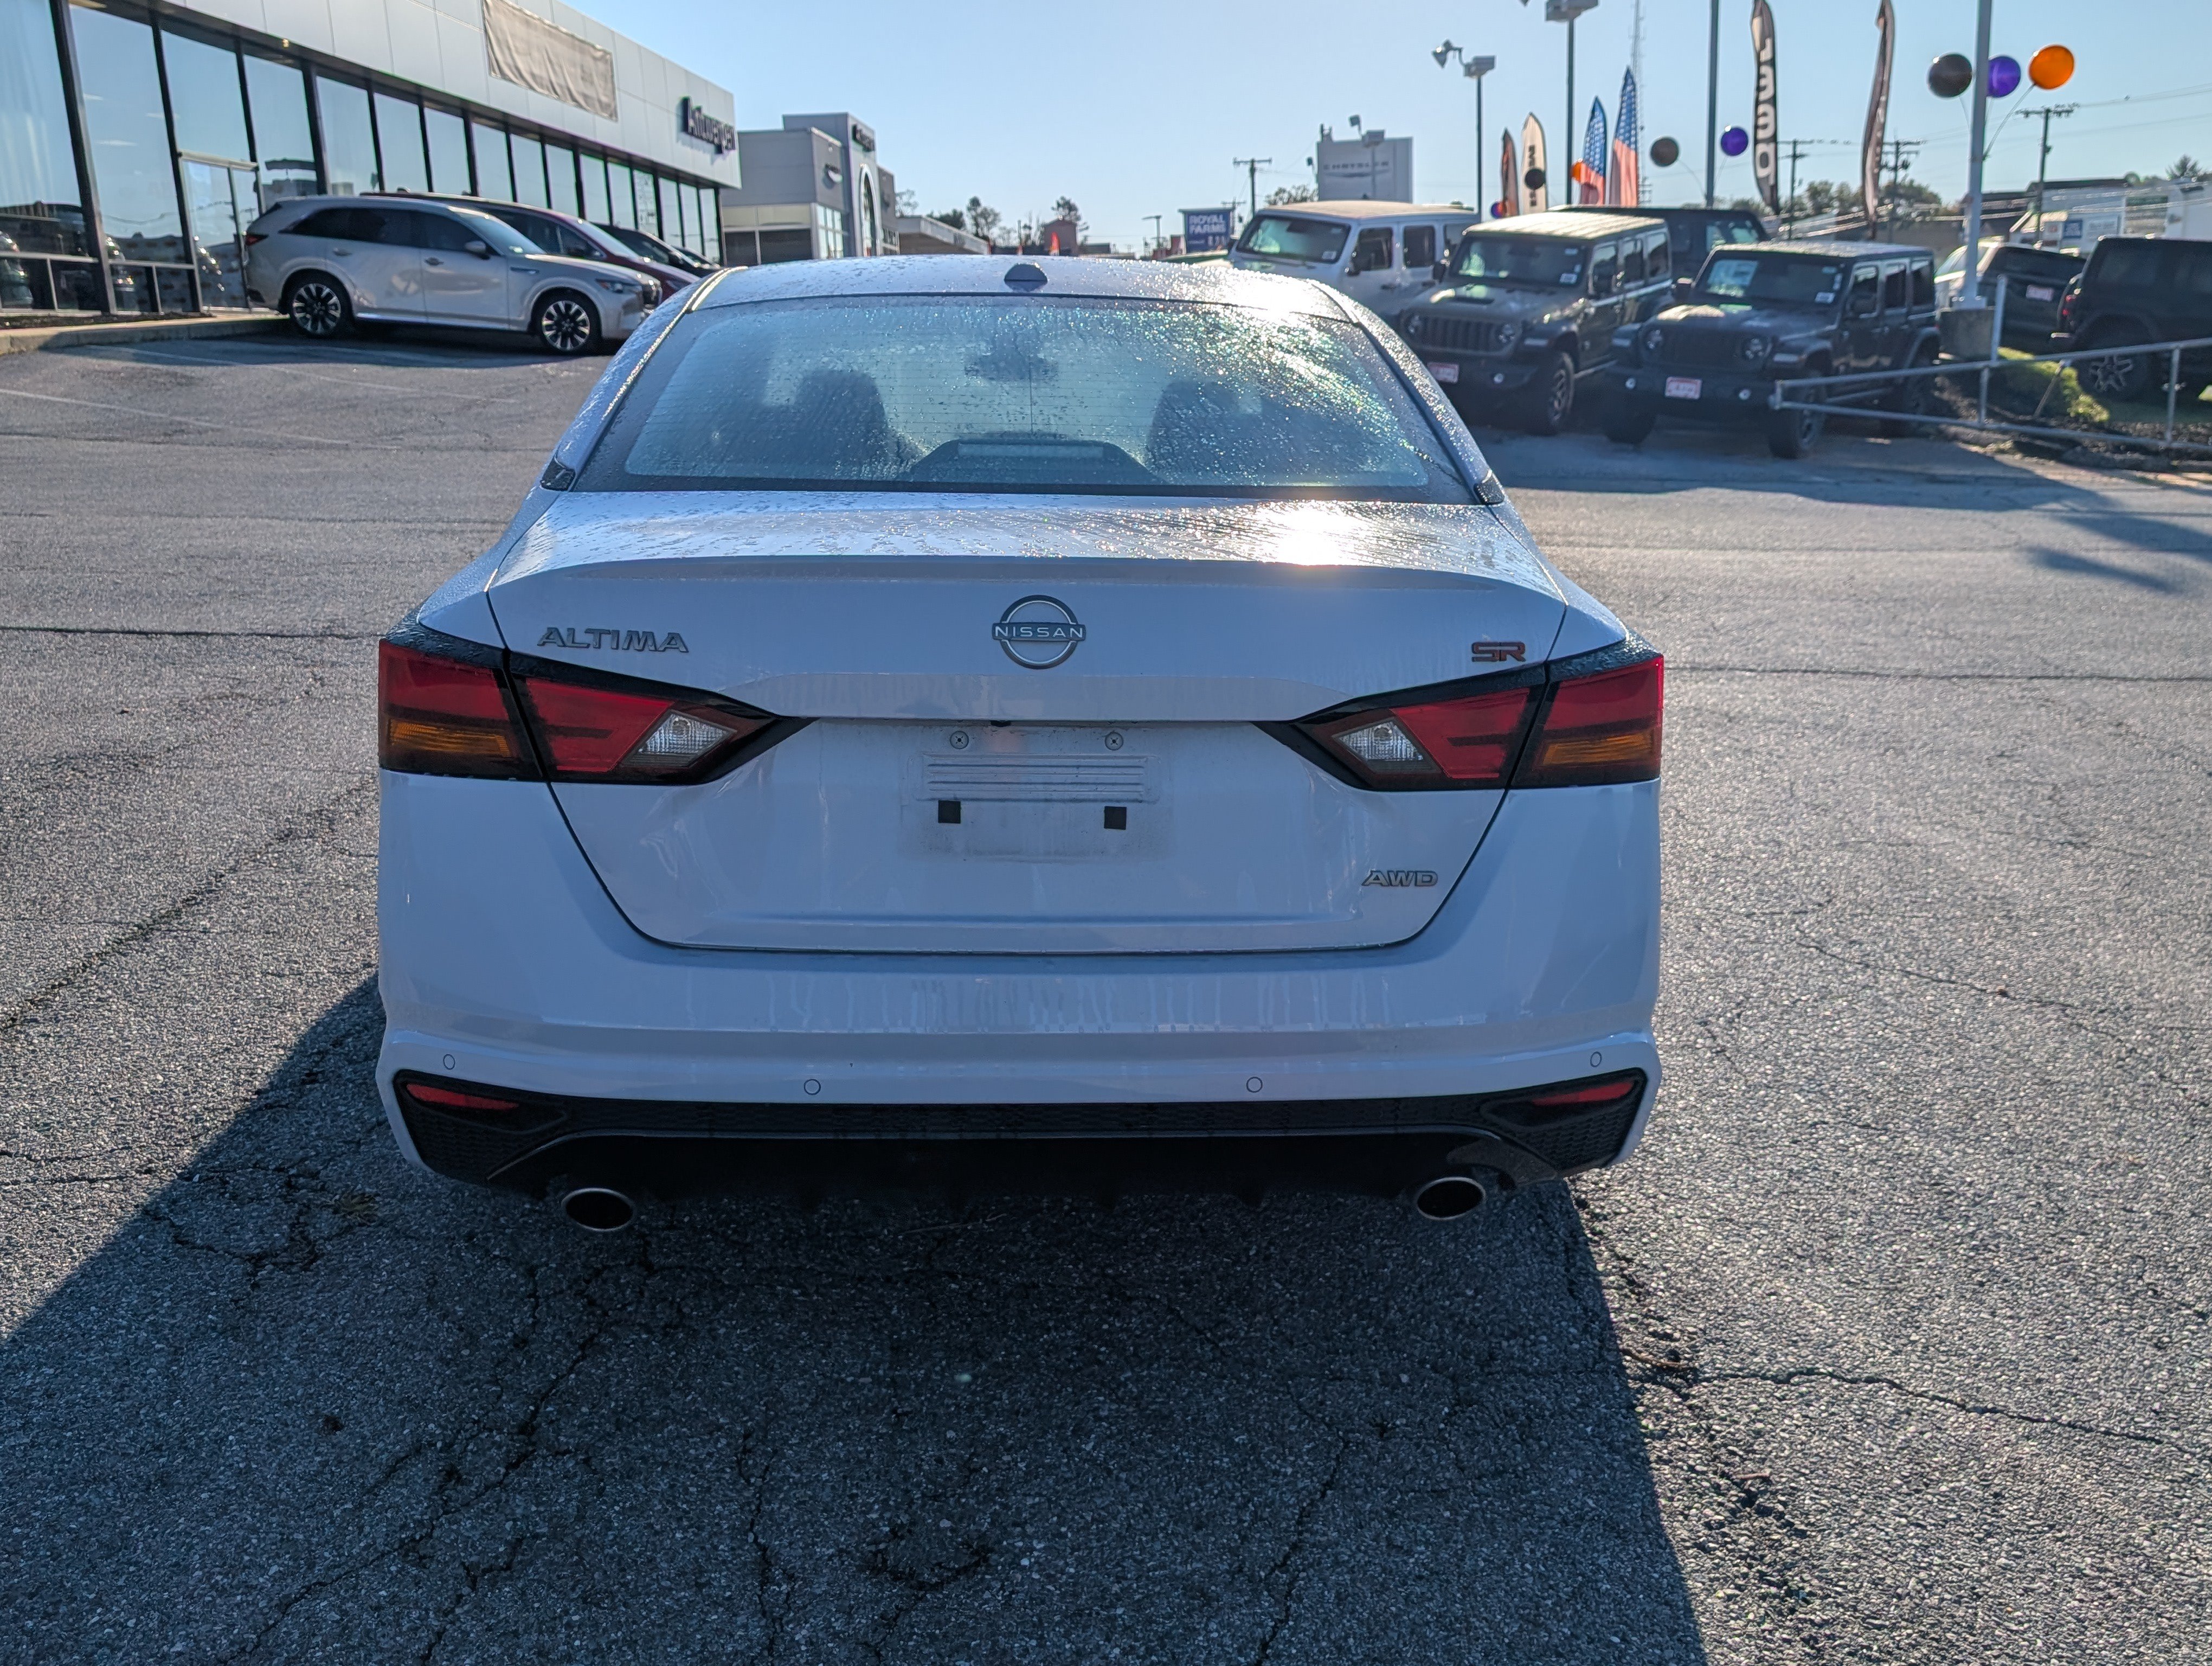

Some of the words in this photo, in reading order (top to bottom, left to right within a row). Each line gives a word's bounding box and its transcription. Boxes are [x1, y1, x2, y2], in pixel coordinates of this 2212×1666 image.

[1189, 214, 1225, 224] ROYAL
[1189, 224, 1226, 234] FARMS
[995, 626, 1083, 638] NISSAN
[537, 627, 689, 653] ALTIMA
[1471, 642, 1526, 662] SR
[1361, 870, 1438, 887] AWD
